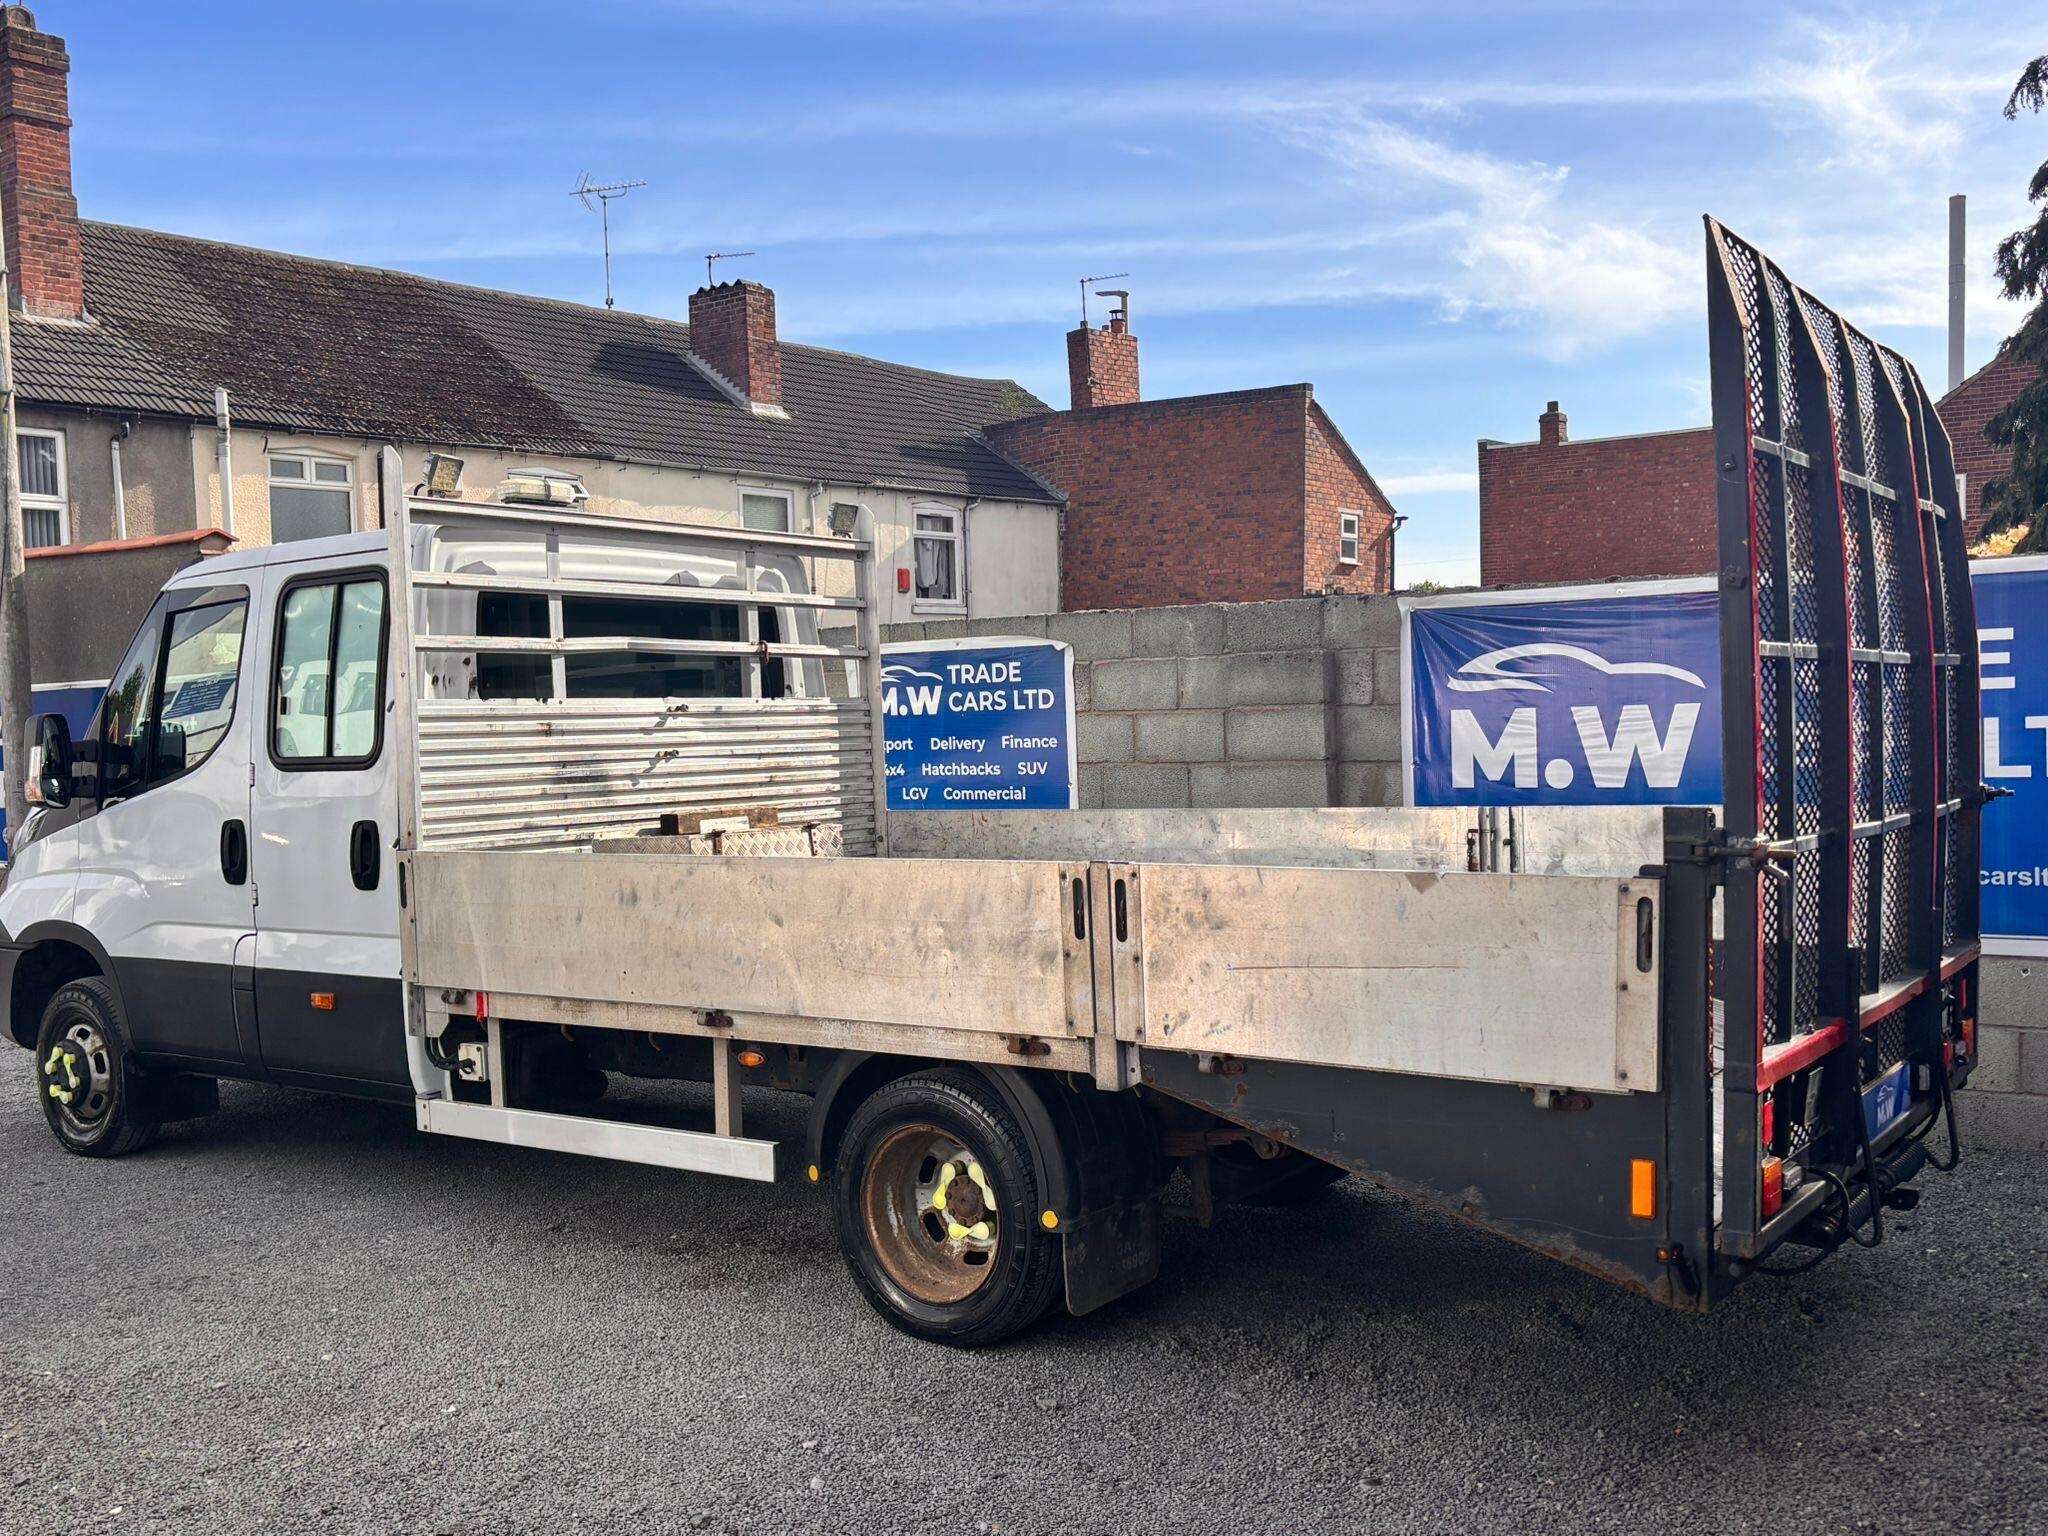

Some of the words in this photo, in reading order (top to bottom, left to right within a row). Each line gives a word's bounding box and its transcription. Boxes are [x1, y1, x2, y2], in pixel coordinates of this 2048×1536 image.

[947, 661, 1022, 685] TRADE
[882, 685, 943, 716] M.W
[948, 690, 1007, 712] CARS
[1013, 688, 1055, 710] LTD
[930, 736, 985, 753] Delivery
[1001, 734, 1058, 749] Finance
[1450, 702, 1702, 789] M.W
[921, 762, 1001, 777] Hatchbacks
[1017, 761, 1048, 775] SUV
[902, 787, 929, 800] LGV
[943, 786, 1026, 801] Commercial
